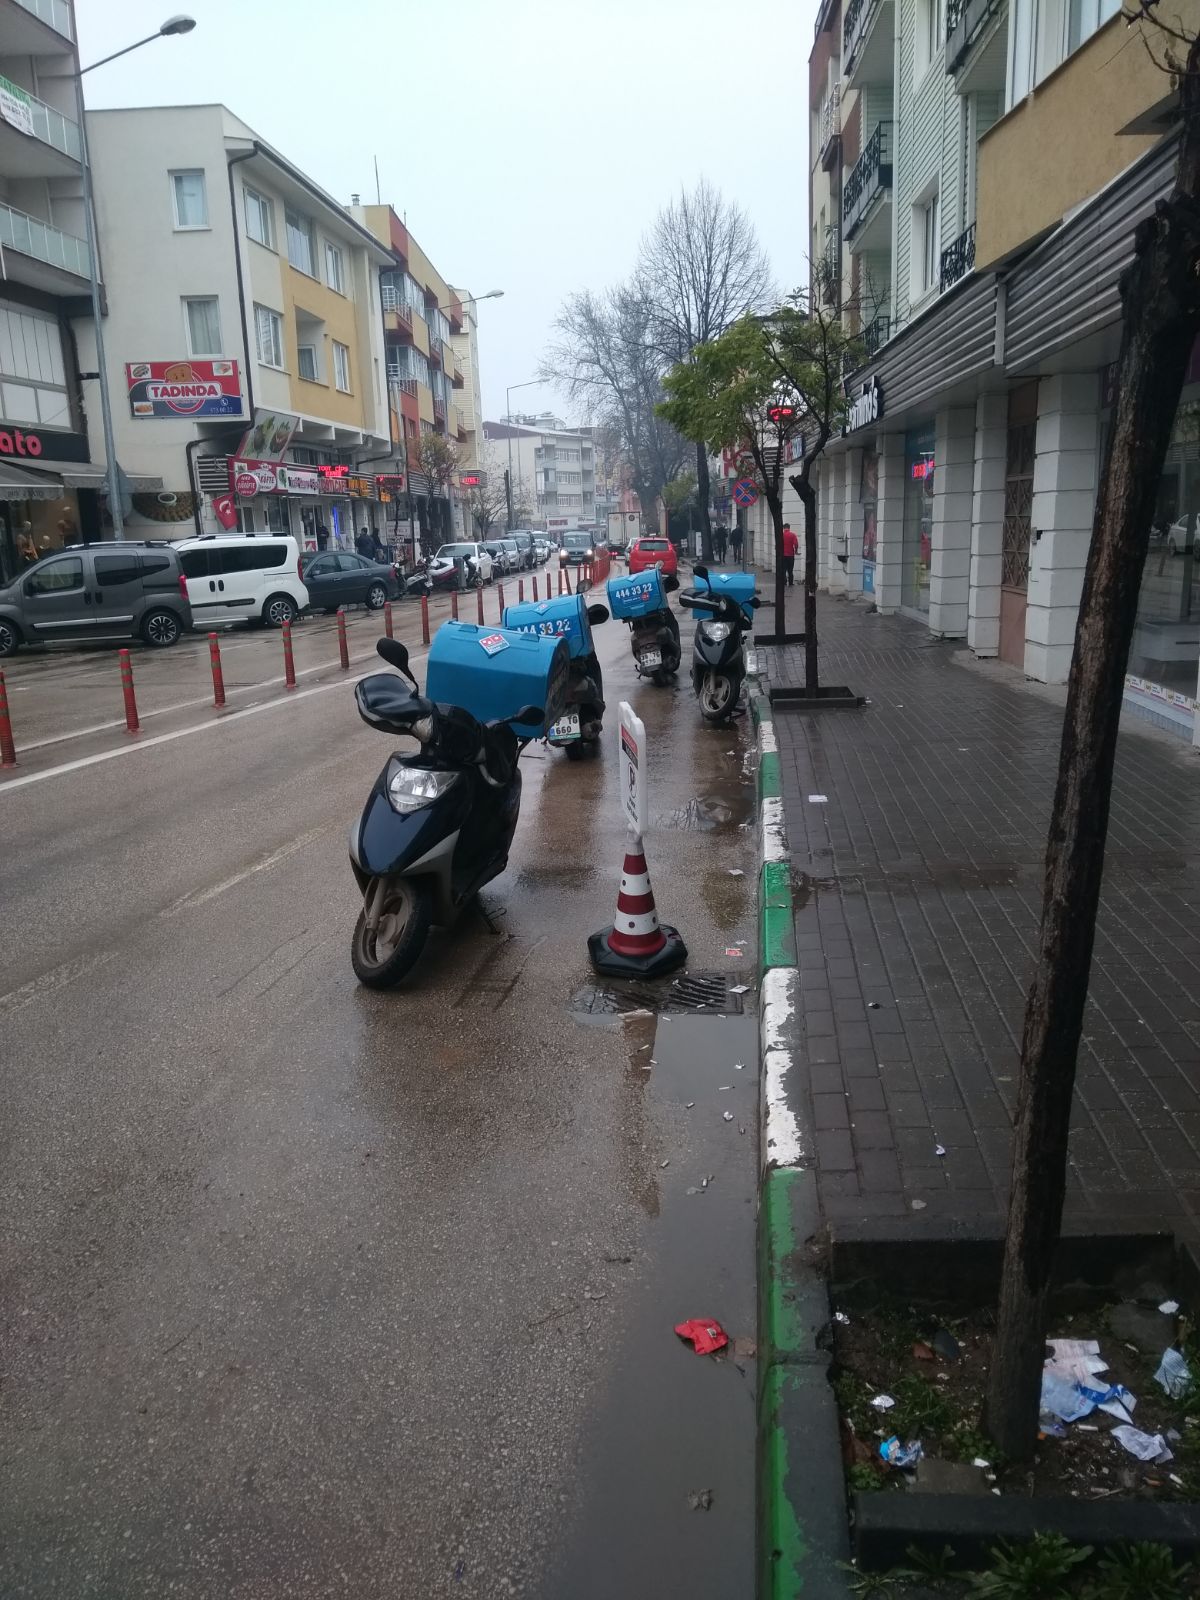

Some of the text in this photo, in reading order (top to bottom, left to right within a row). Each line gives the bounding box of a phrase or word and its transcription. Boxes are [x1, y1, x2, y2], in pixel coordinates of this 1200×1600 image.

[151, 384, 219, 398] TADINDA
[844, 375, 879, 434] omino's
[0, 429, 42, 456] ato
[615, 588, 630, 599] 444
[631, 585, 642, 595] 33
[642, 582, 653, 592] 22
[540, 620, 554, 635] 33
[556, 619, 571, 632] 22
[556, 725, 572, 735] 660
